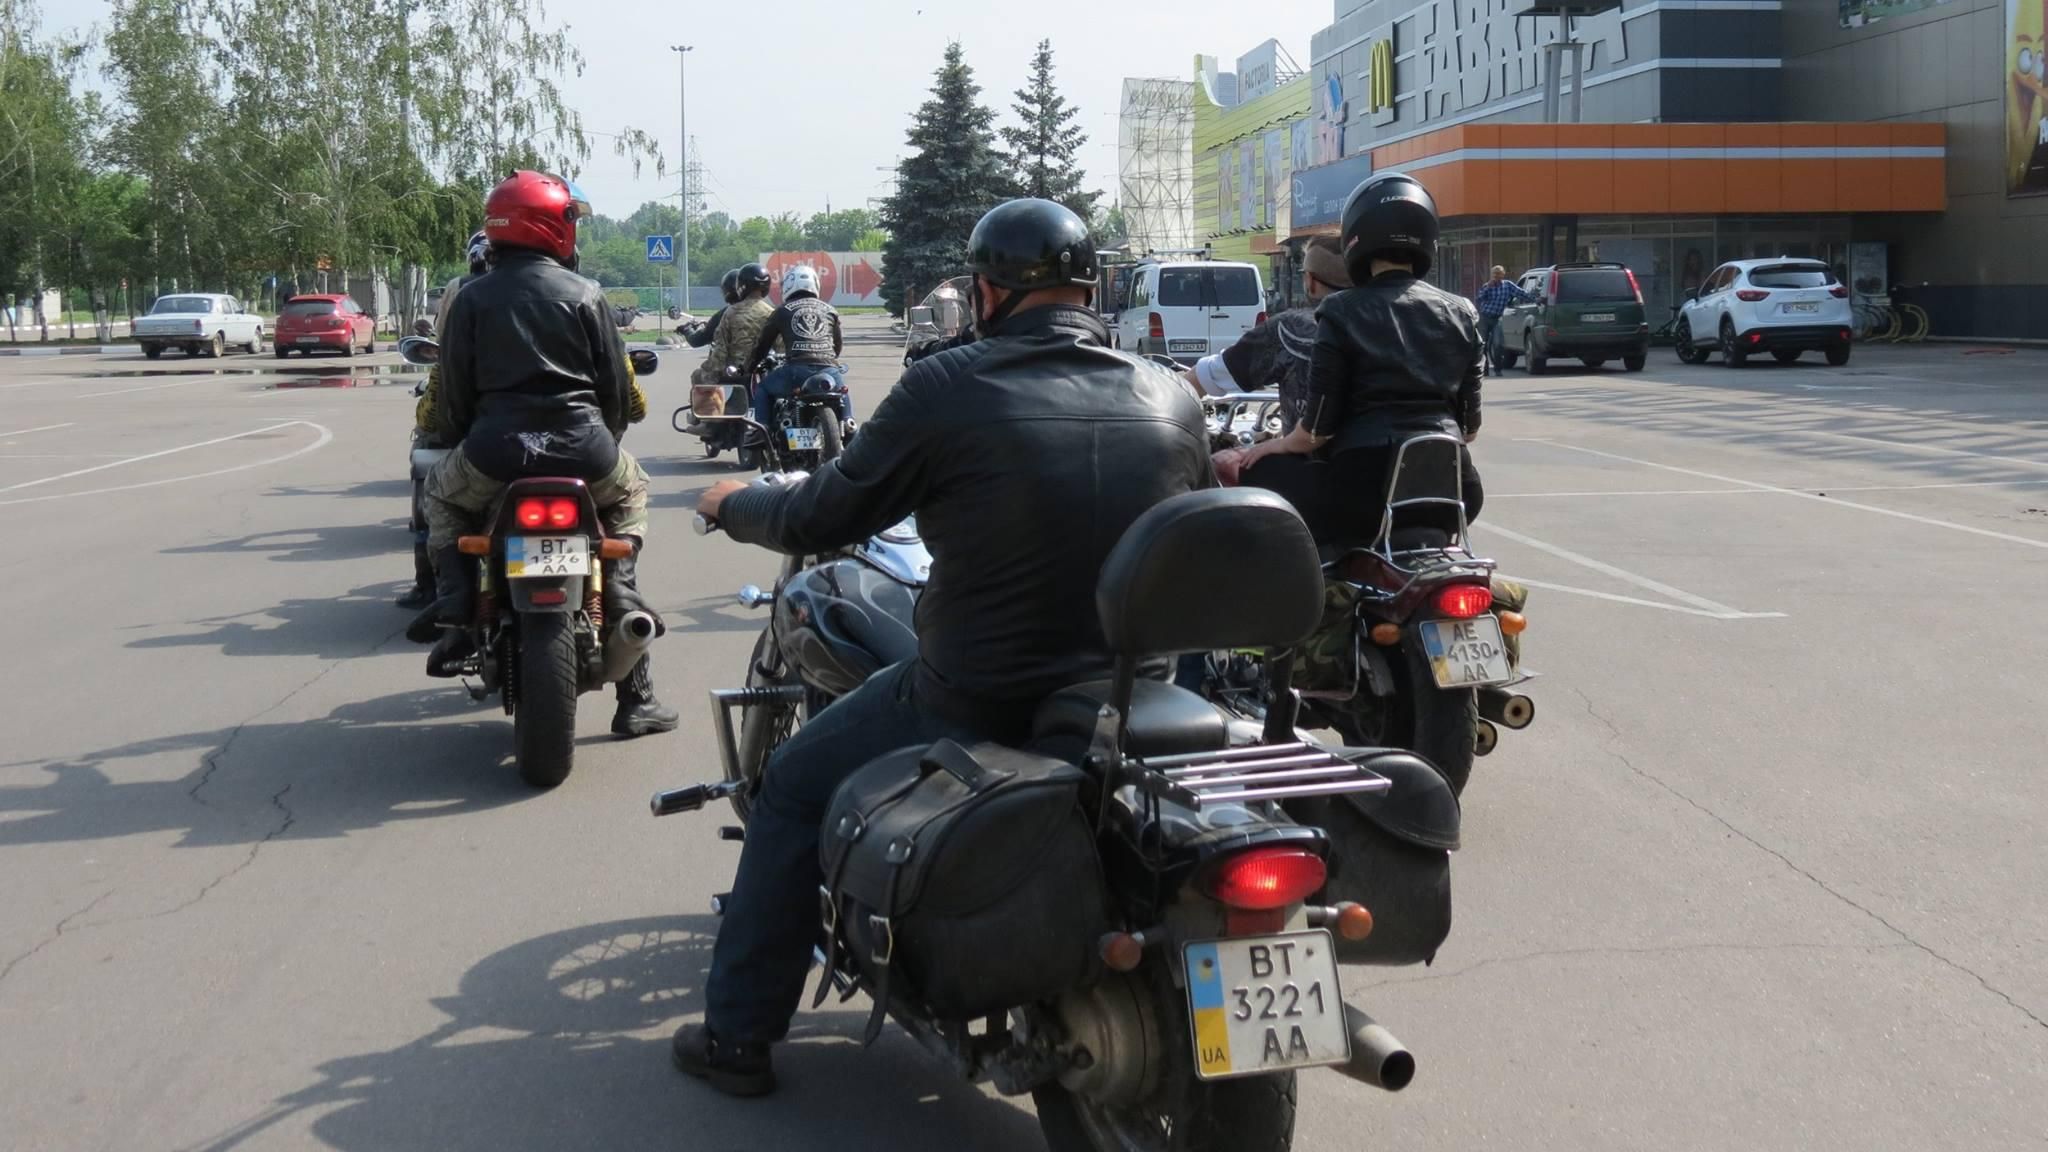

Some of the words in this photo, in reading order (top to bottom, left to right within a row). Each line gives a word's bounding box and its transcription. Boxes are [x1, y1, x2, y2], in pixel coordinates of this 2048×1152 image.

[541, 539, 568, 554] BT
[531, 555, 579, 564] 1576
[543, 565, 568, 574] AA
[1454, 622, 1478, 641] AE
[1447, 642, 1493, 662] 4130
[1463, 663, 1489, 682] AA
[1249, 941, 1296, 979] BT
[1231, 980, 1326, 1022] 3221
[1263, 1025, 1310, 1063] AA
[1202, 1047, 1226, 1065] UA
